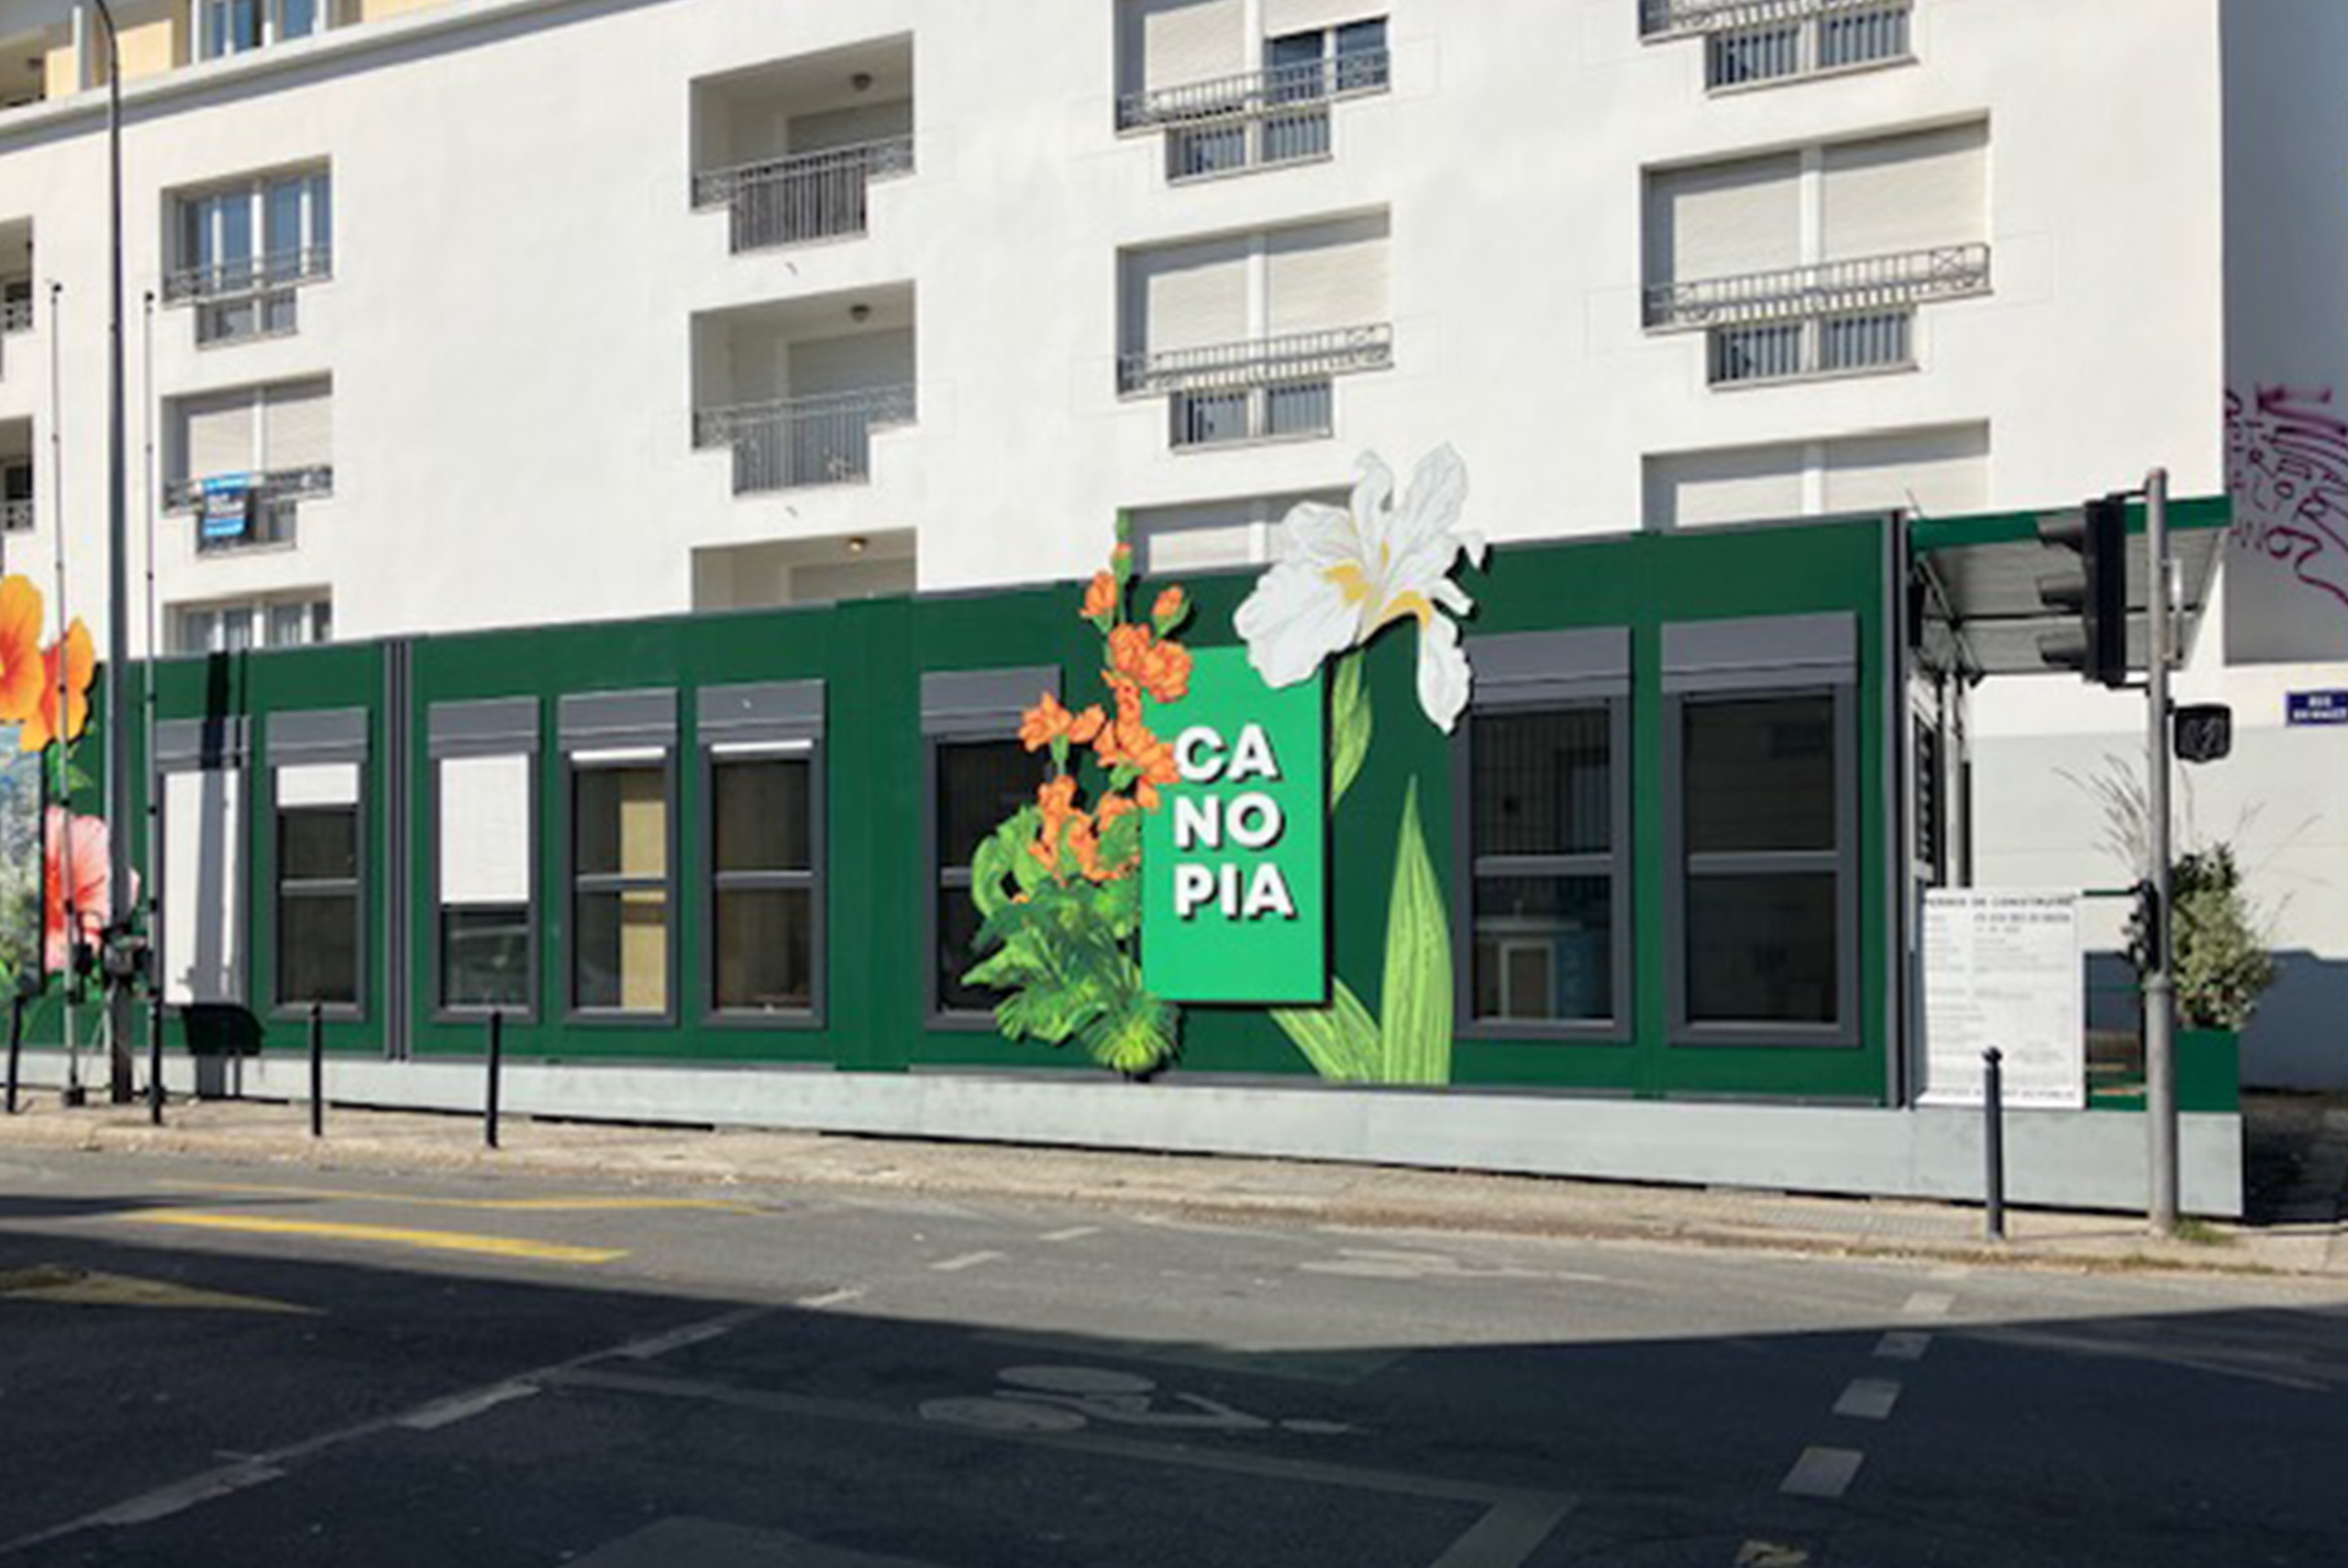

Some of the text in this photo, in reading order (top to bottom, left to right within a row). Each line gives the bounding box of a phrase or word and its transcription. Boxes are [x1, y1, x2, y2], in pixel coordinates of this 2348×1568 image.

[1174, 723, 1283, 783] CA
[1174, 792, 1285, 851] NO
[1174, 863, 1299, 922] PIA
